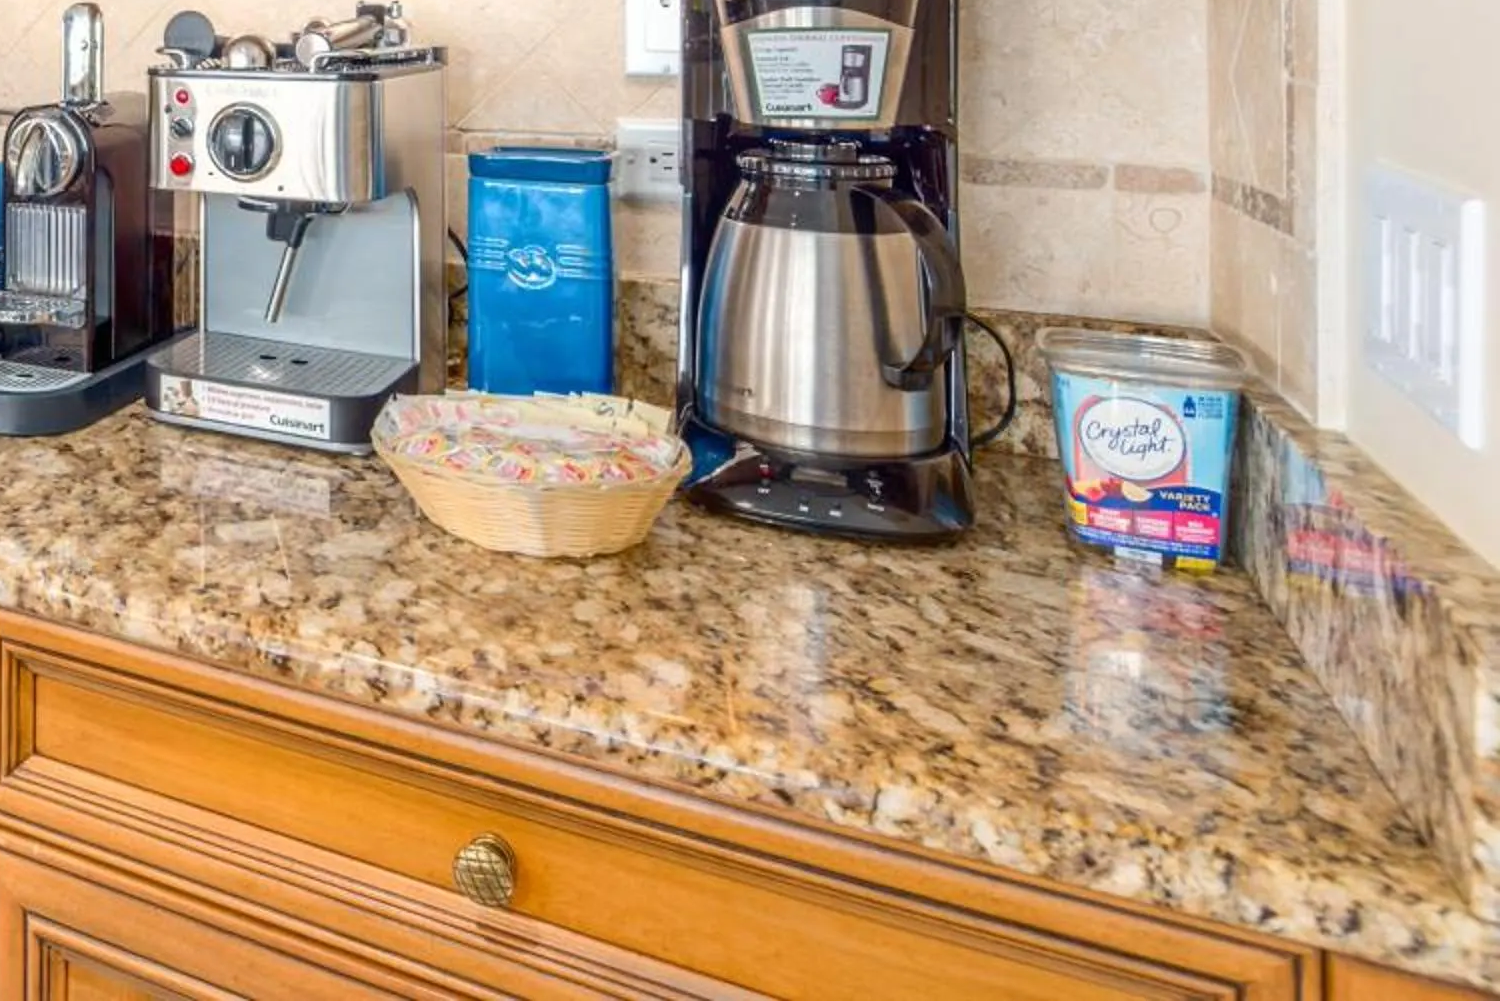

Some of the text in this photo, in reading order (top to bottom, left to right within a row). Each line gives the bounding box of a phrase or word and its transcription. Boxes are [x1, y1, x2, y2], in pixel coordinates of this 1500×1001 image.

[269, 413, 325, 433] Cuisinart
[1085, 416, 1162, 451] Crystal
[1159, 490, 1211, 502] VARIETY
[1179, 502, 1211, 512] PACK
